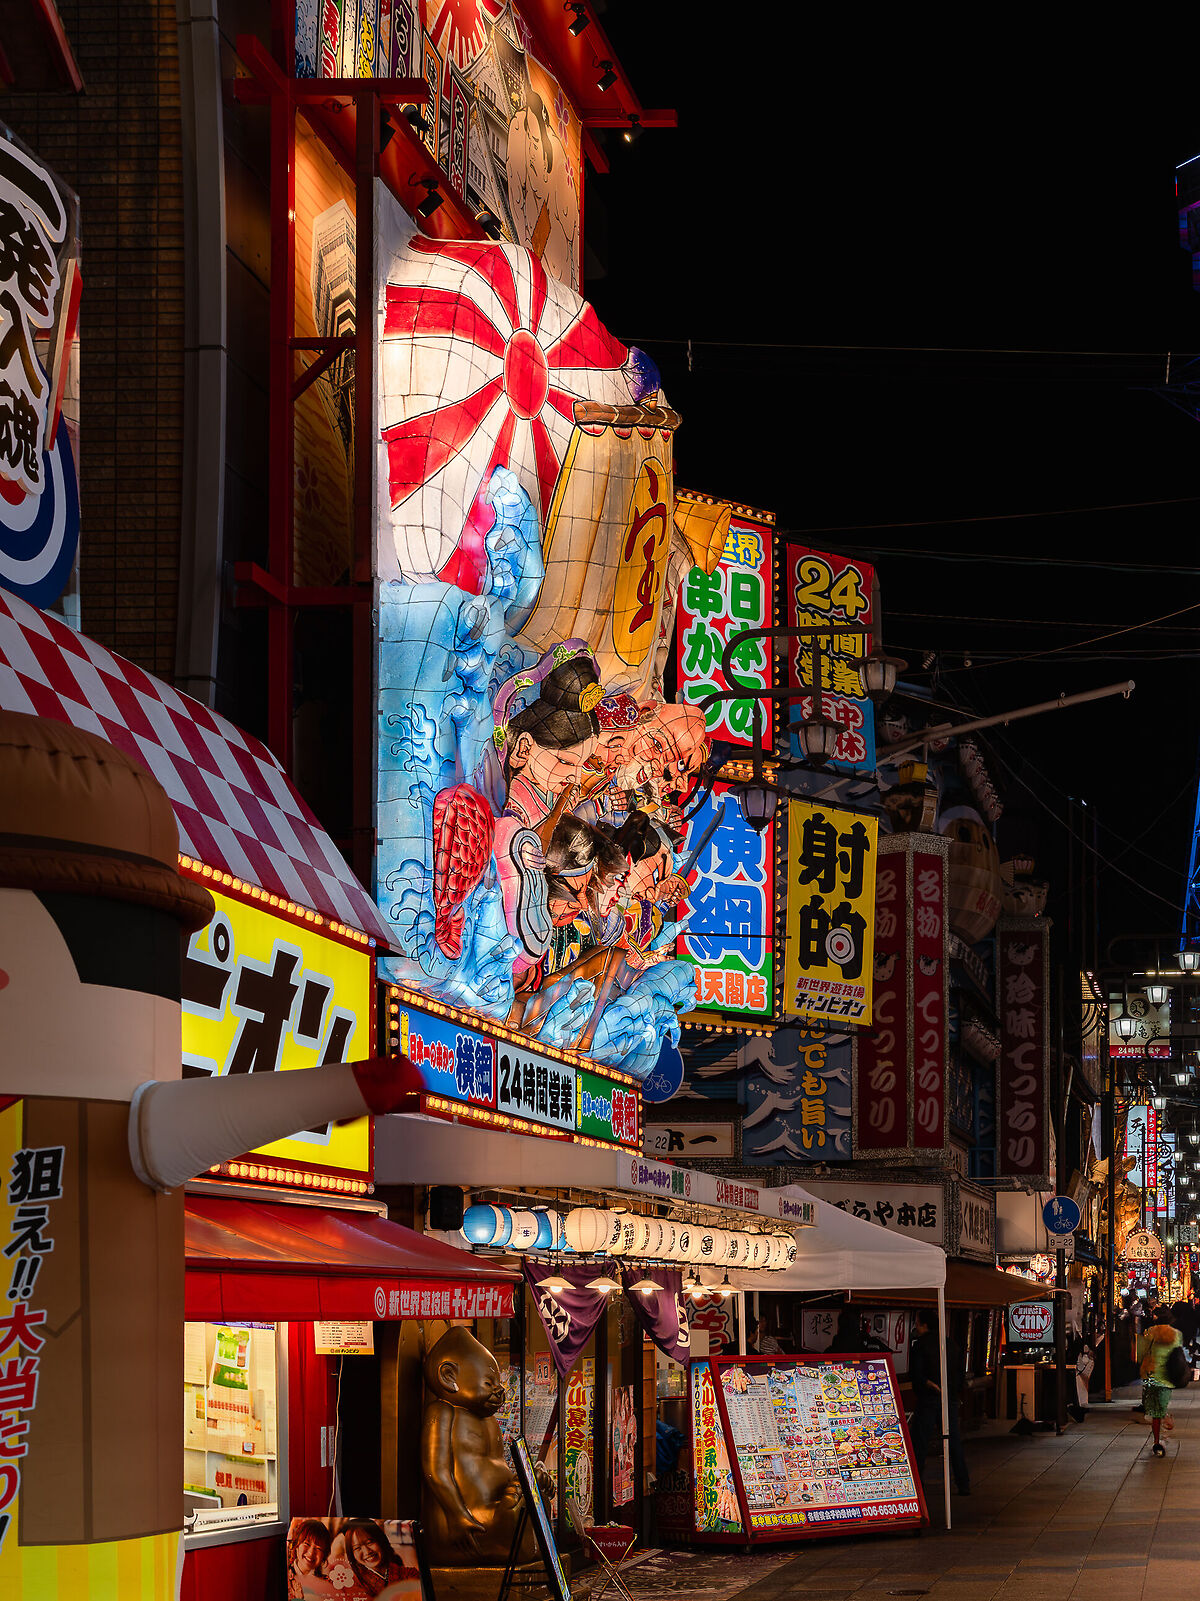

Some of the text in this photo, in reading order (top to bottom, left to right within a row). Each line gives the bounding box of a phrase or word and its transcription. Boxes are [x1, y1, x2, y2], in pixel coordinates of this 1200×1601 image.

[797, 560, 867, 617] 24
[686, 565, 725, 729] 串かつ
[729, 571, 764, 738] 日本一の
[686, 786, 765, 970] 横綱
[797, 811, 871, 980] 射的
[794, 992, 867, 1018] チャンピオン
[796, 976, 865, 998] 新世界遊技場
[455, 1033, 494, 1102] 横綱
[499, 1054, 574, 1123] 24時間営業
[869, 990, 897, 1132] てっちり
[916, 991, 941, 1133] てっちり
[1005, 973, 1039, 1168] 珍味てっちり
[1050, 1238, 1073, 1246] 9-22
[867, 1502, 918, 1516] 06-6630-8440
